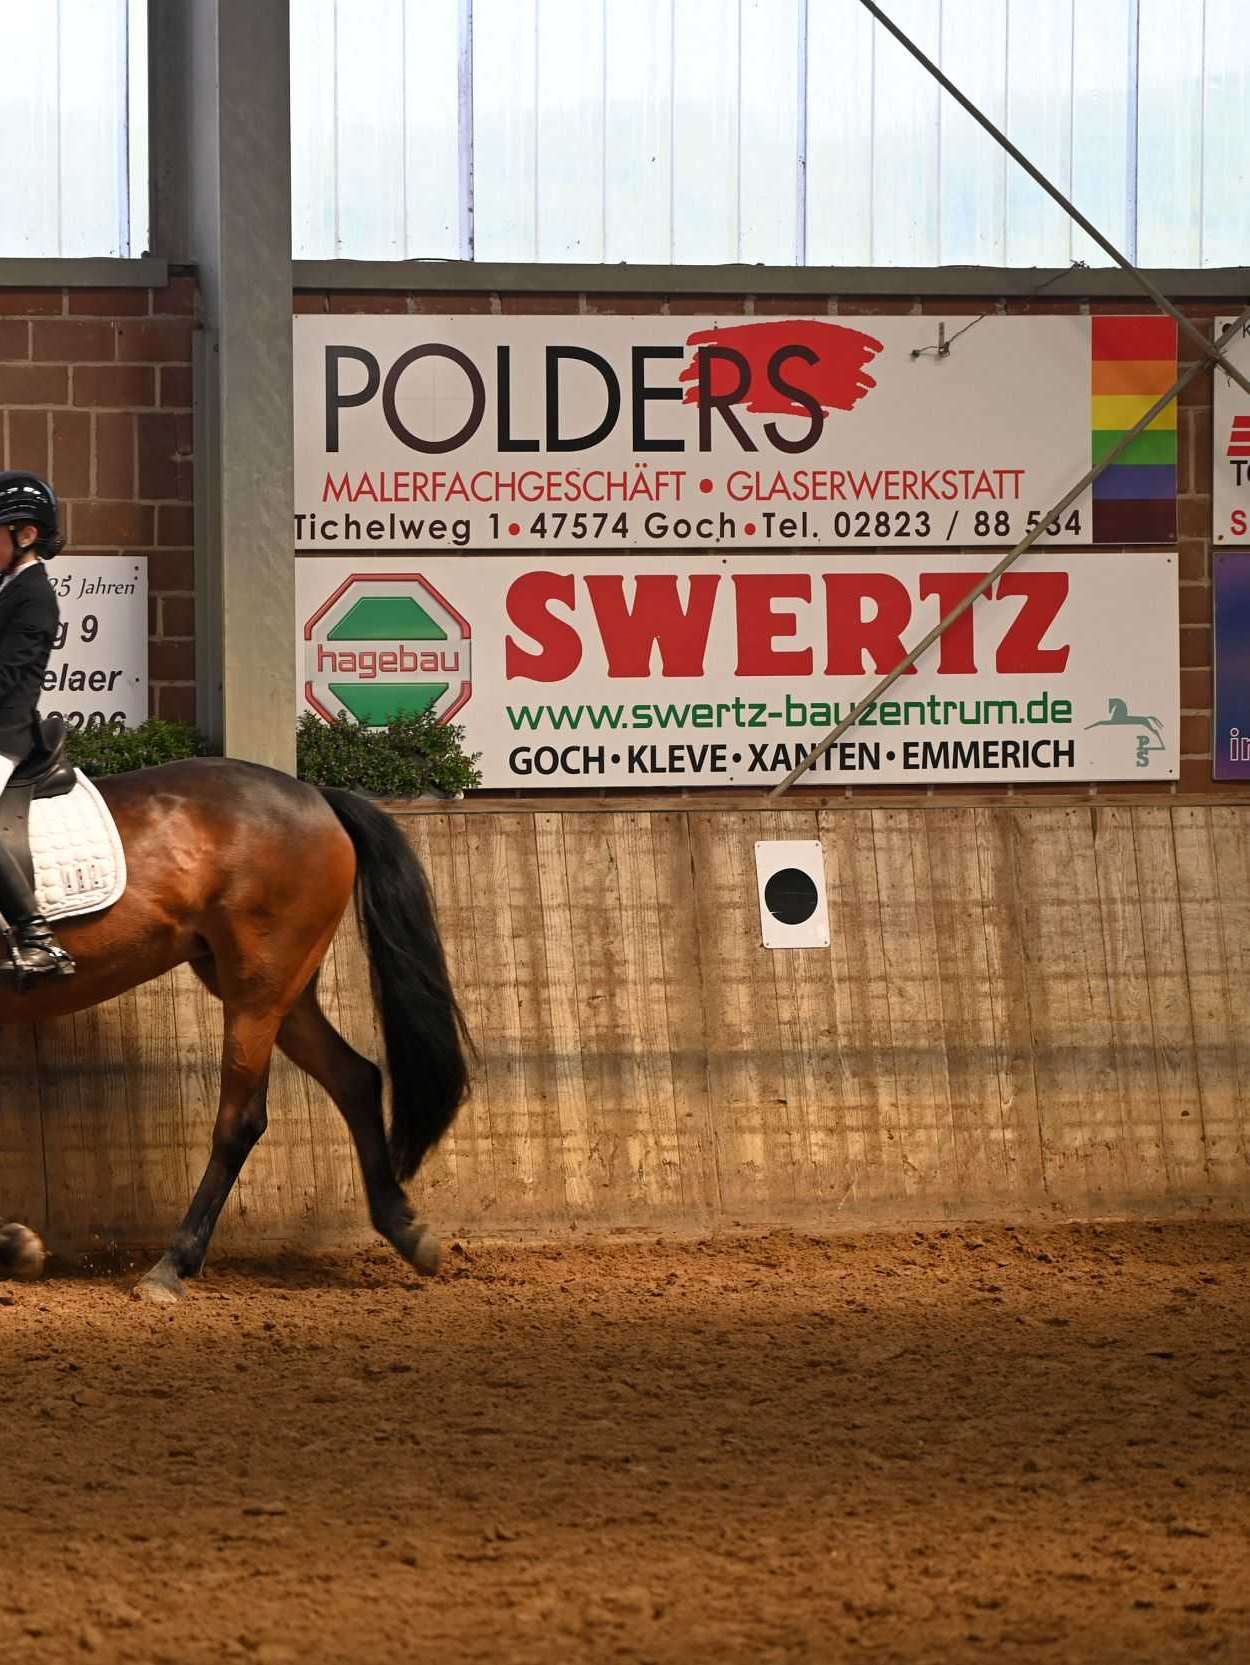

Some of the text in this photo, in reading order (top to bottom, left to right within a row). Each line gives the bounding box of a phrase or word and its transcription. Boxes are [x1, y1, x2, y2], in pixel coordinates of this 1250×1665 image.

[325, 343, 824, 454] POLDERS
[323, 463, 1025, 502] MALERFACHGESCHÄFT GLASERWERKSTATT
[294, 513, 470, 546] Tichelweg
[489, 513, 498, 539] 1
[530, 512, 628, 539] 47574
[645, 512, 735, 542] Goch
[763, 512, 818, 538] Tel.
[835, 511, 930, 537] 02823
[974, 511, 1010, 536] 88
[78, 576, 135, 599] Jahren
[81, 615, 98, 642] 9
[506, 571, 1070, 682] SWERTZ
[41, 663, 123, 691] elaer
[317, 644, 459, 679] hagebau
[506, 692, 1072, 730] www.swertz-bauzentrum.de
[509, 740, 1074, 775] GOCH KLEVE XANTEN EMMERICH
